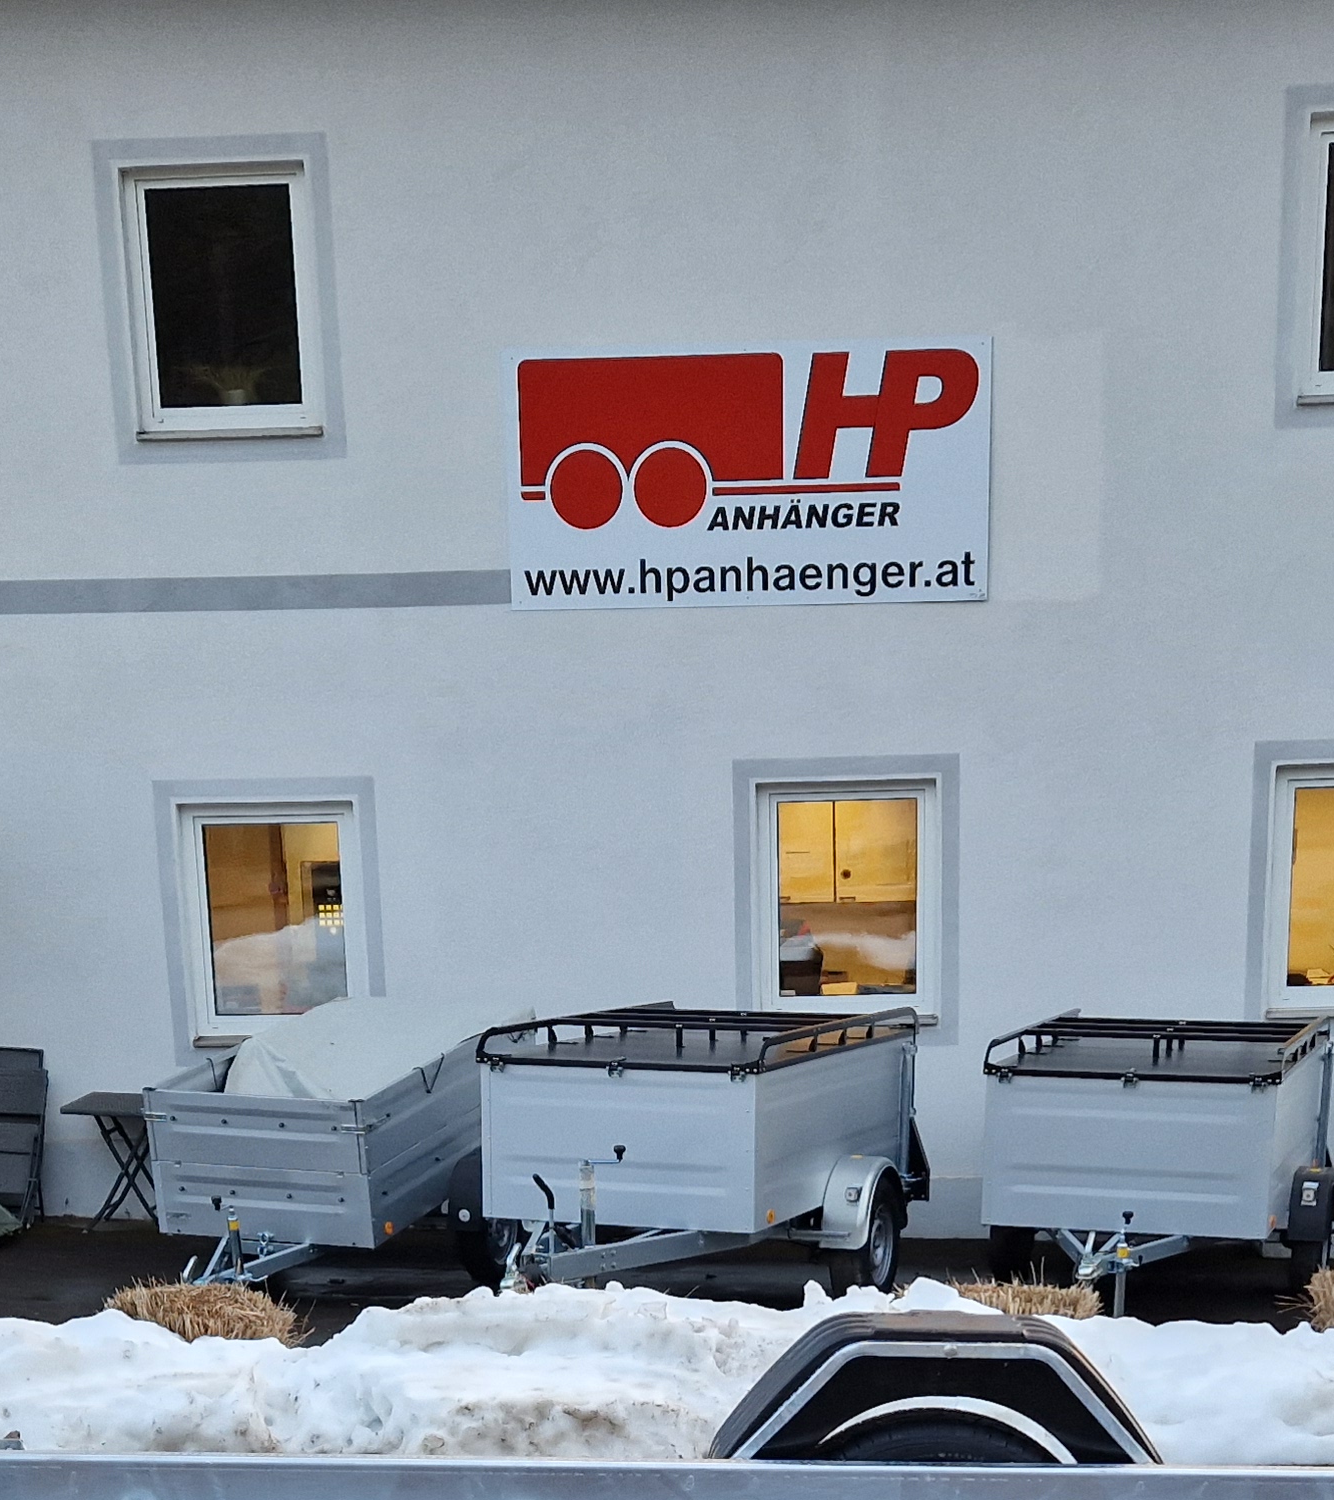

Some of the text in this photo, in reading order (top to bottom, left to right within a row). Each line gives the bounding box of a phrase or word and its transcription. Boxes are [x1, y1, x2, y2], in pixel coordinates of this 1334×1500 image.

[793, 348, 979, 480] HP
[707, 498, 901, 531] ANHÄNGER
[524, 552, 976, 601] www.hpanhaenger.at
